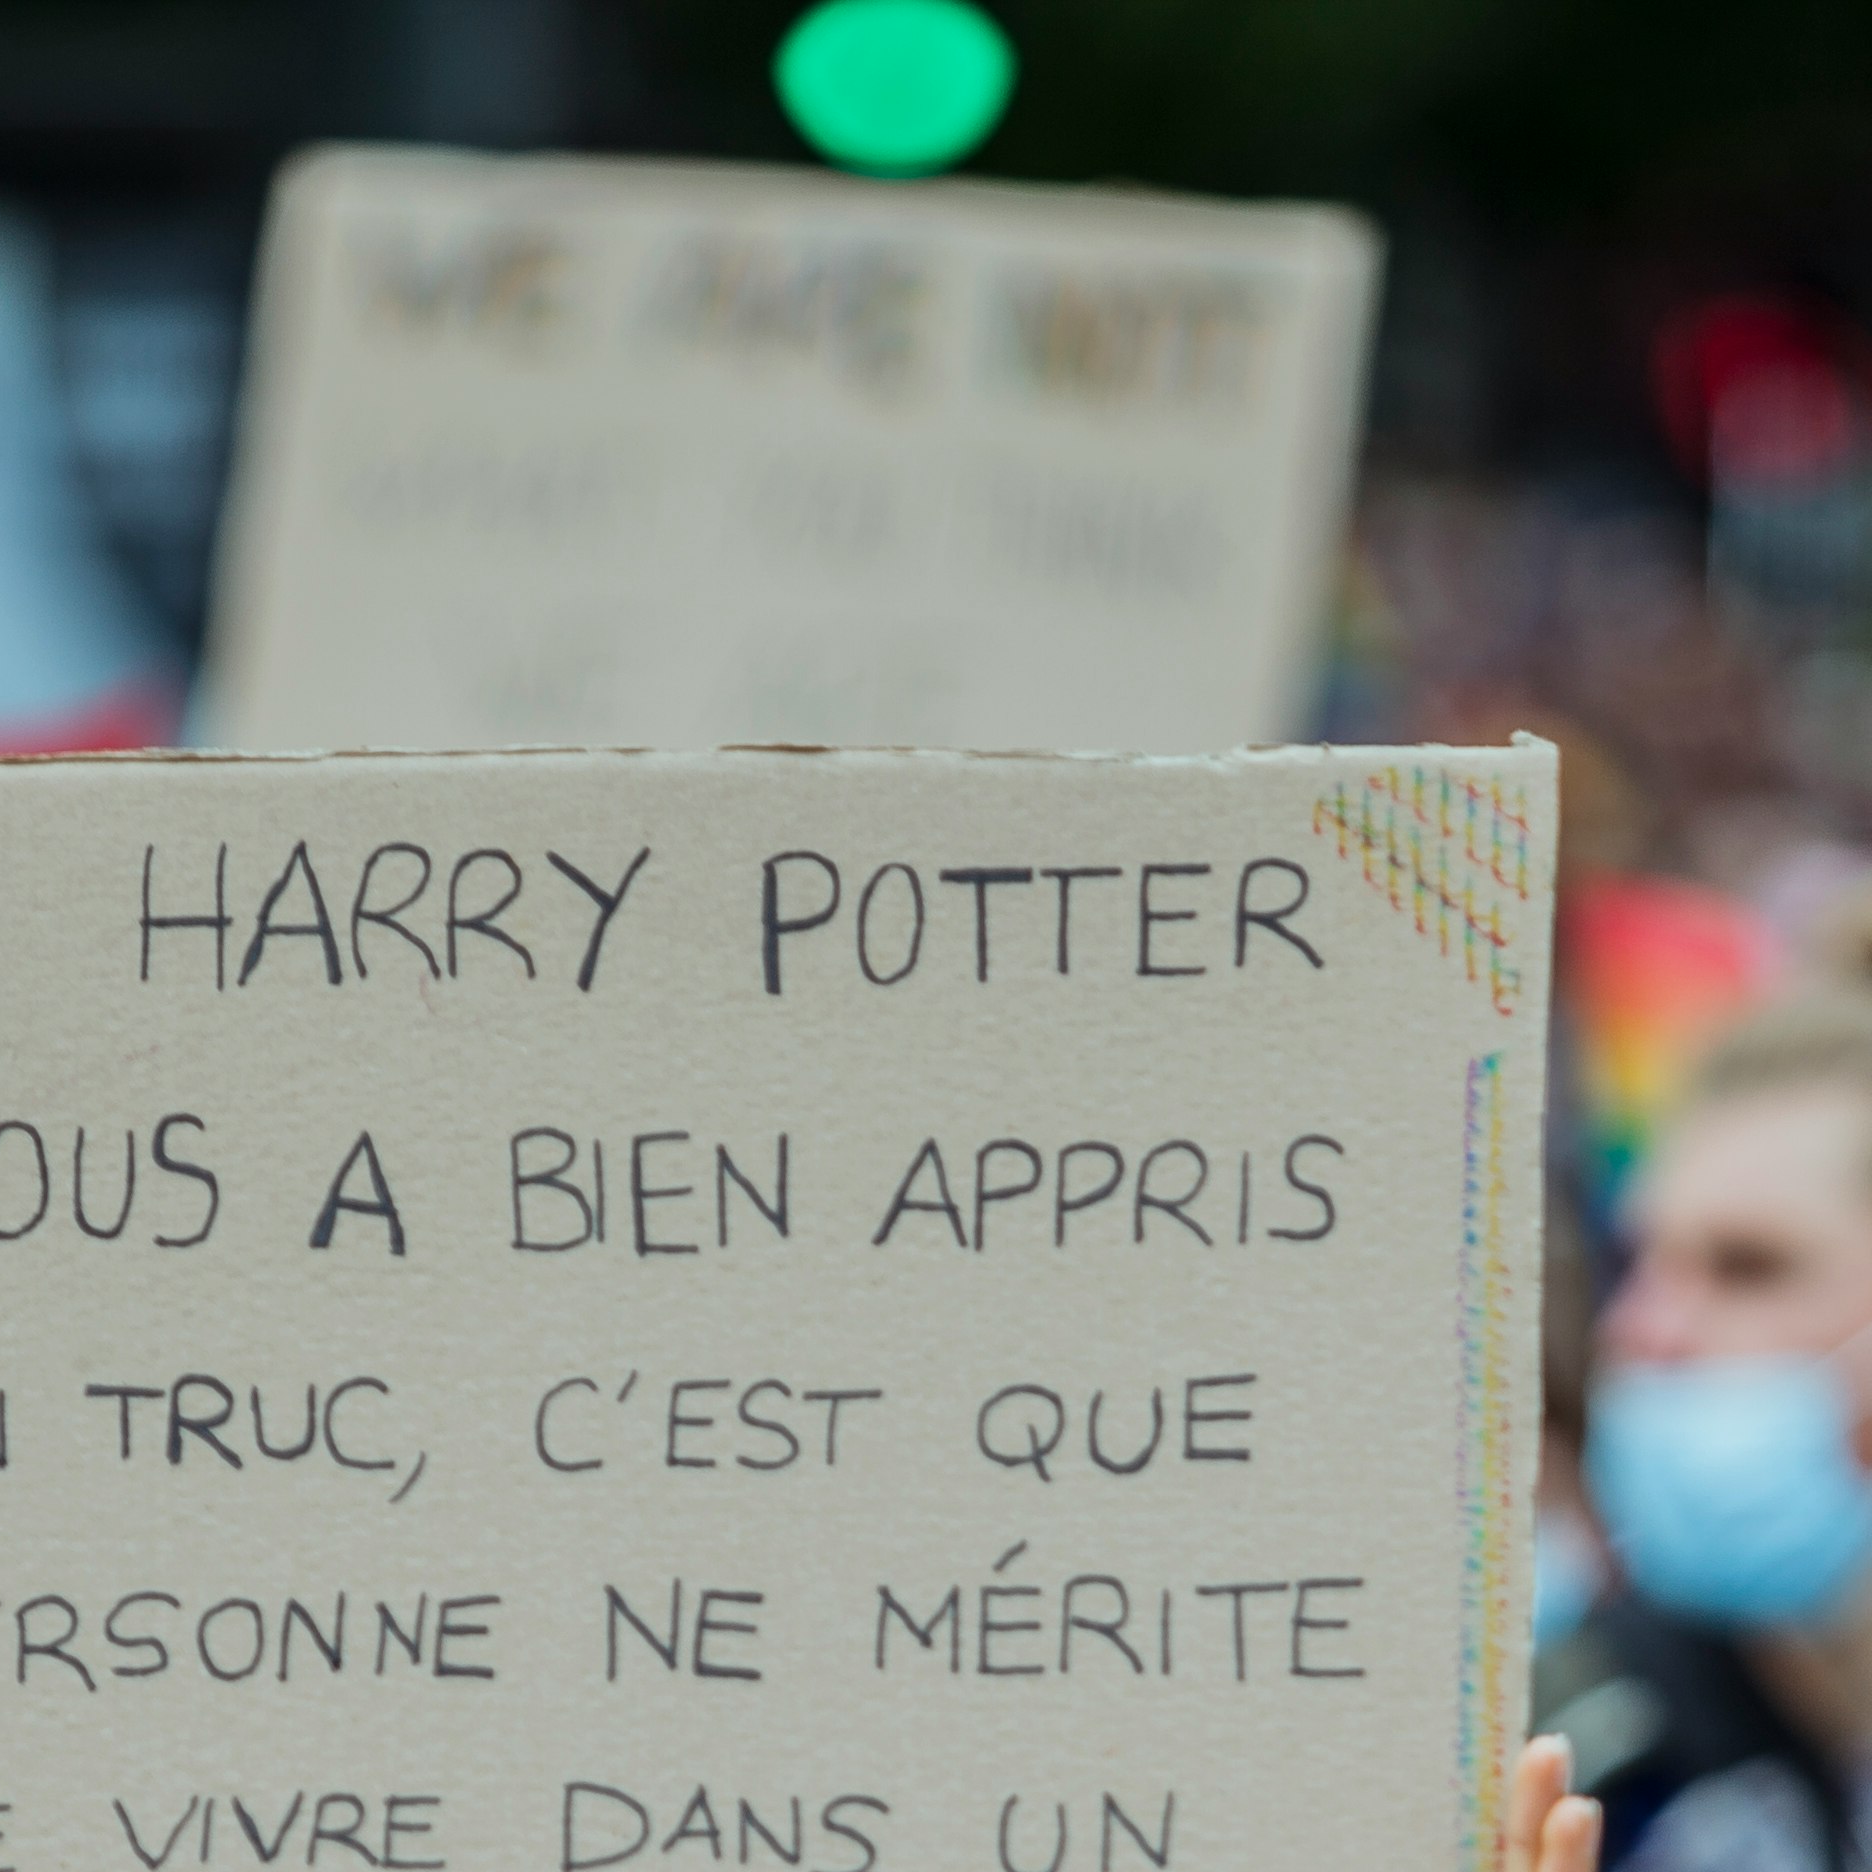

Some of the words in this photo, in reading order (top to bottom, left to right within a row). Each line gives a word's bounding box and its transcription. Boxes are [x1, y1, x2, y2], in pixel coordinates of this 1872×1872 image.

[137, 838, 653, 995] HARRY
[759, 849, 1326, 998] POTTER
[307, 1129, 408, 1259] A
[509, 1125, 792, 1259] BIEN
[870, 1132, 1346, 1254] APPRIS
[83, 1372, 427, 1504] TRUC,
[533, 1369, 884, 1474] C'EST
[975, 1372, 1258, 1484] QUE
[603, 1577, 766, 1683] NE
[874, 1540, 1367, 1683] MÉRITE
[112, 1790, 447, 1872] VIVRE
